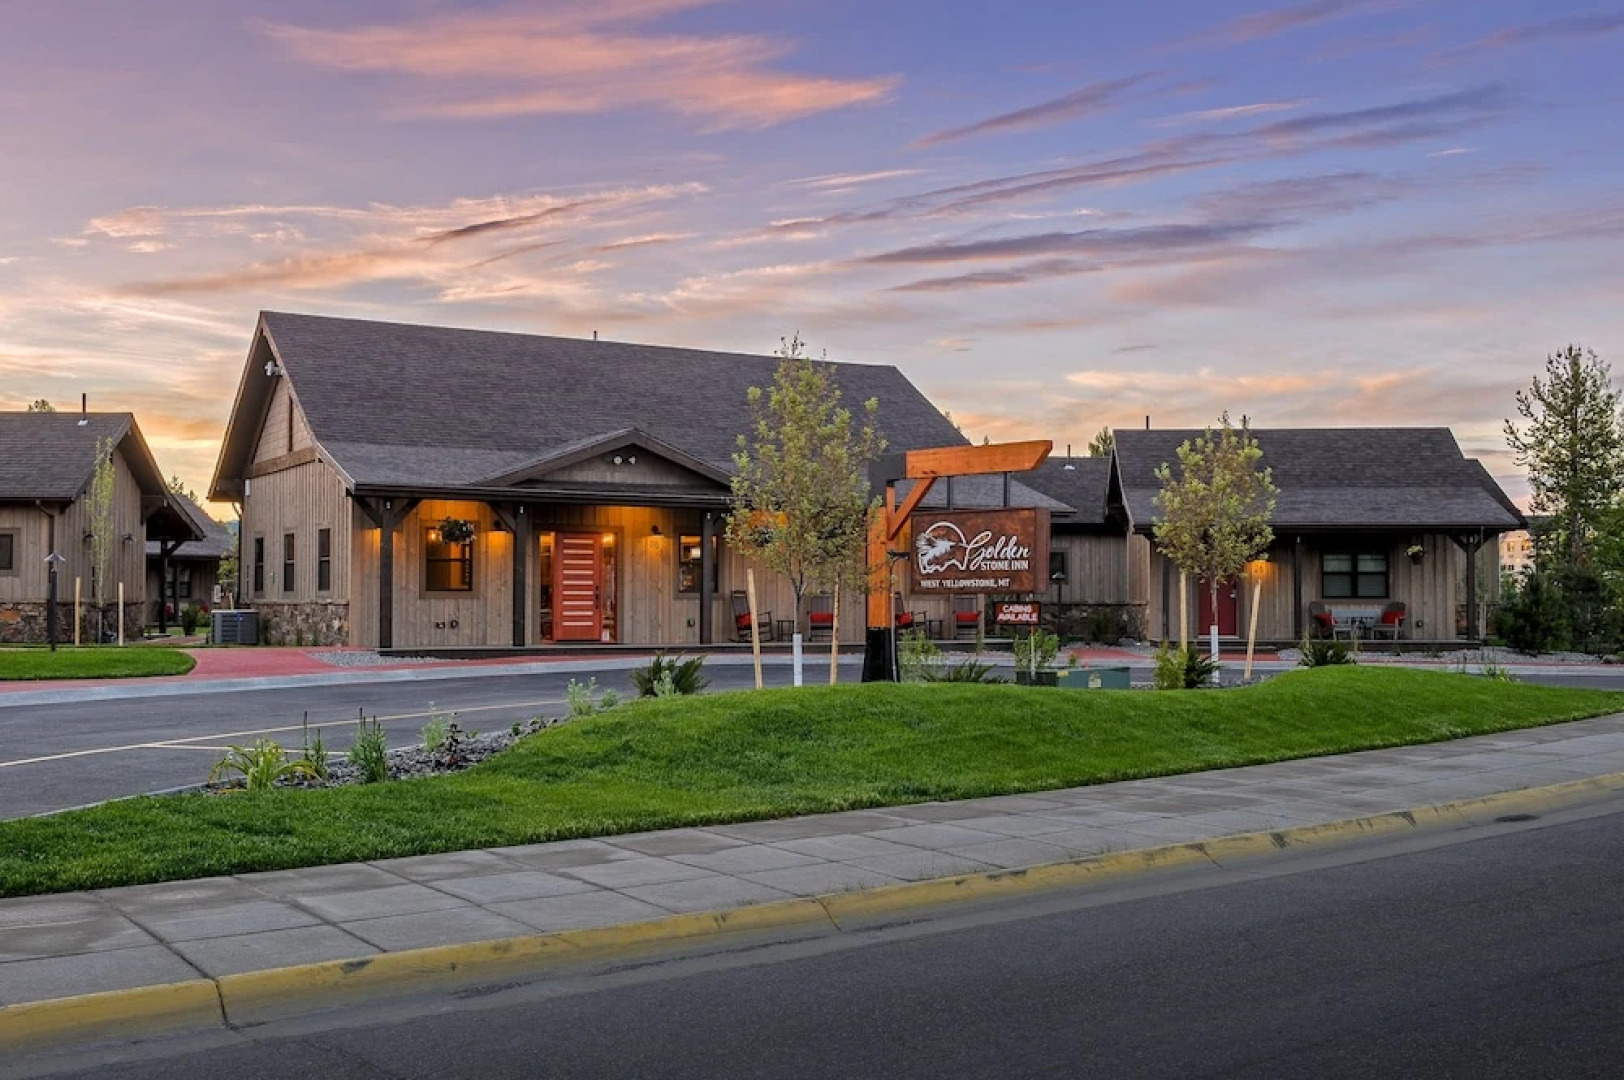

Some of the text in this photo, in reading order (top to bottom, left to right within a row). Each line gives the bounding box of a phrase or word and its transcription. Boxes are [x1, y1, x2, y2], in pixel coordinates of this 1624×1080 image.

[966, 530, 1030, 570] Golden
[981, 560, 1028, 571] STONE INN
[920, 579, 940, 588] WEST
[999, 578, 1010, 587] MT
[996, 612, 1038, 621] AVAILABLE
